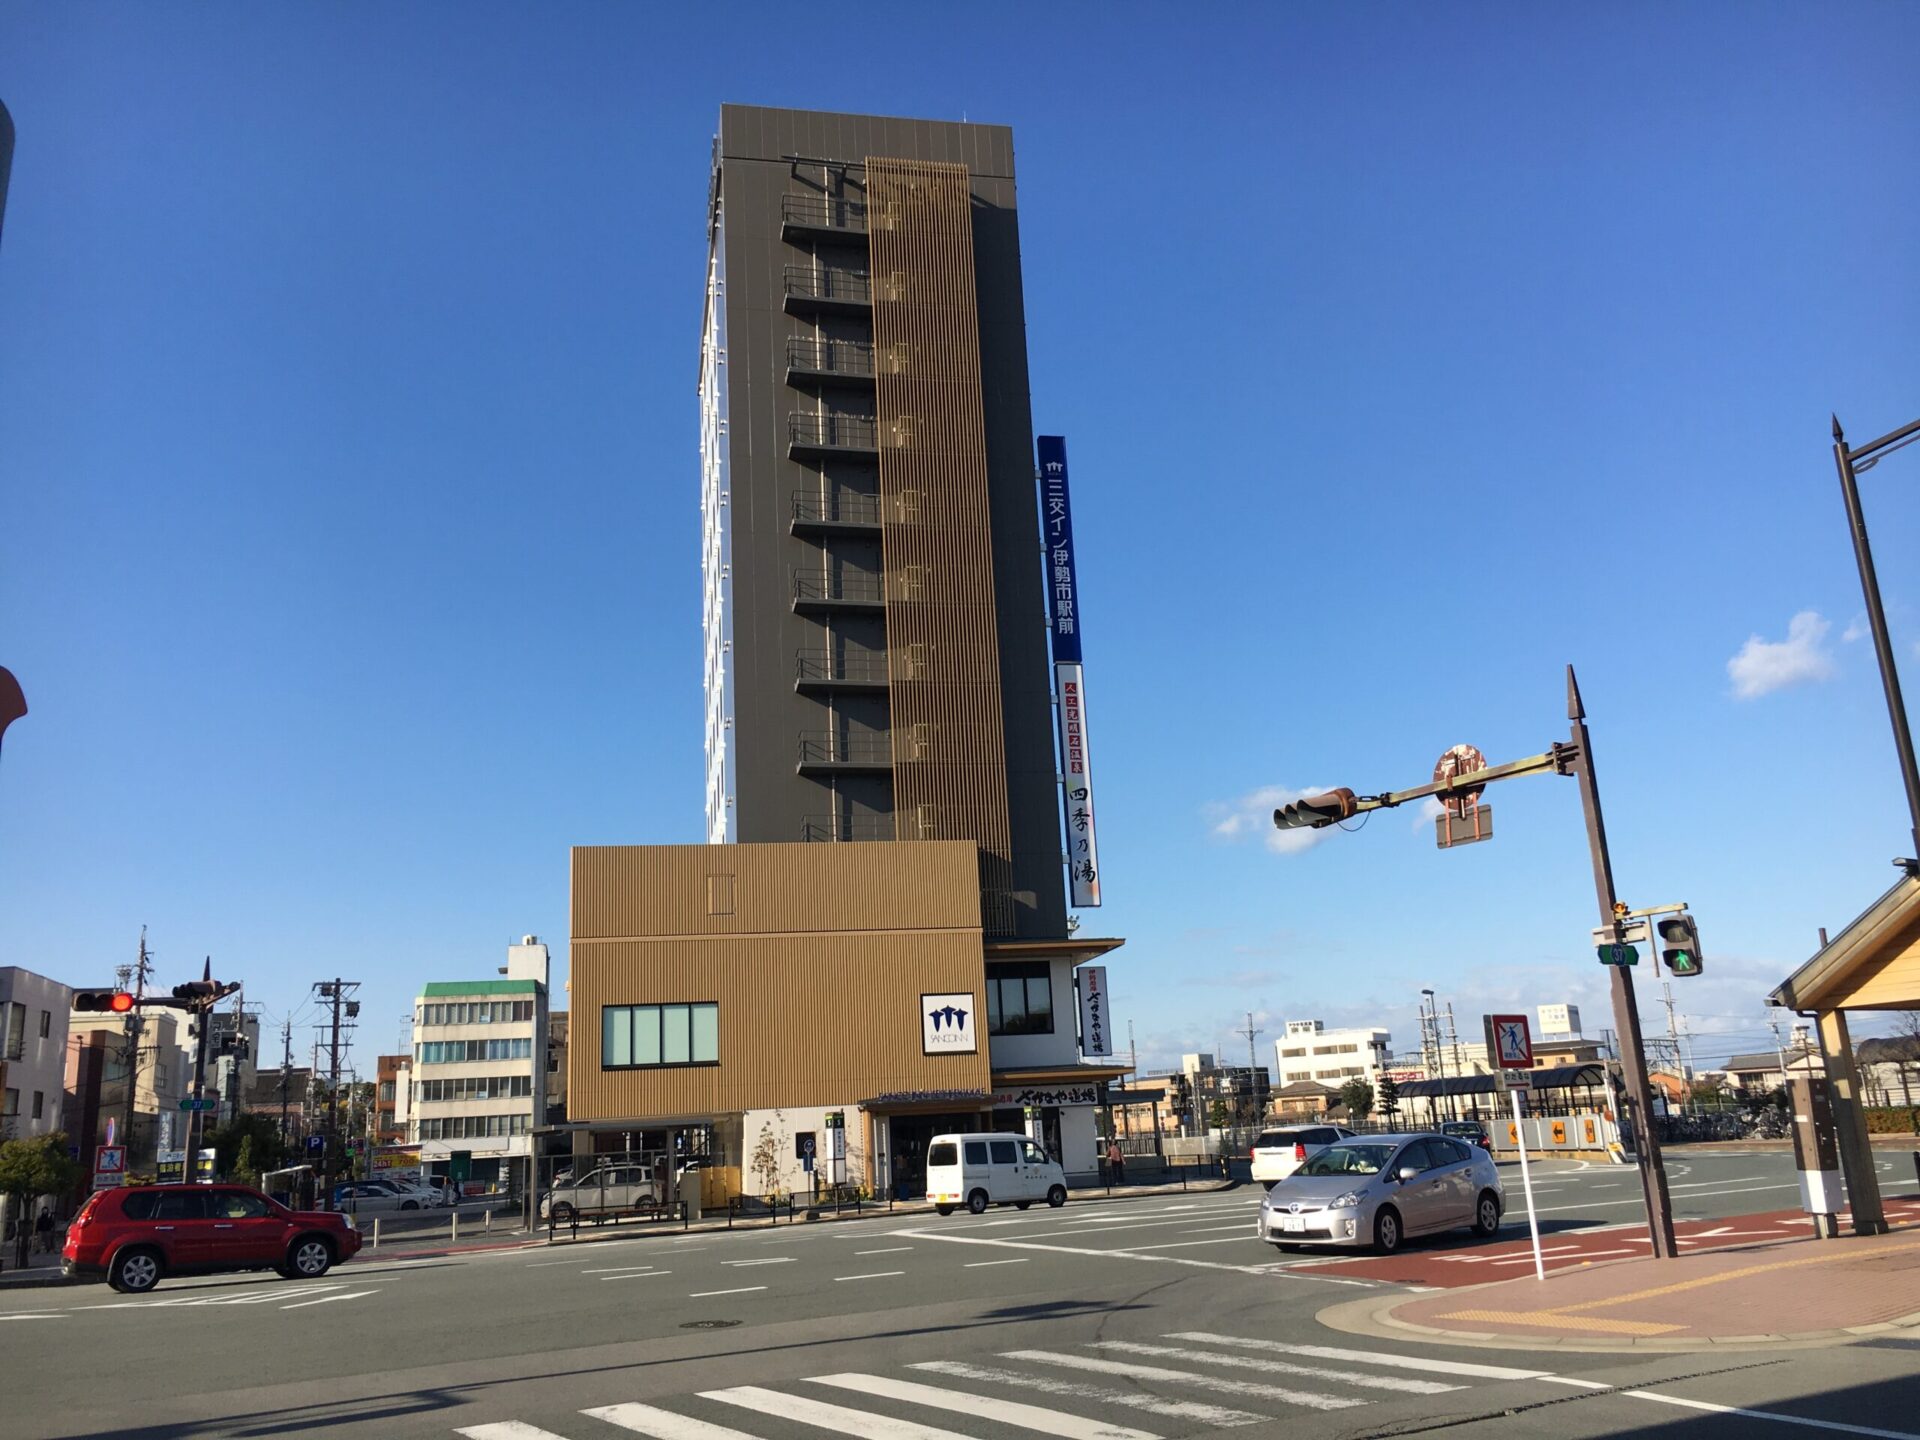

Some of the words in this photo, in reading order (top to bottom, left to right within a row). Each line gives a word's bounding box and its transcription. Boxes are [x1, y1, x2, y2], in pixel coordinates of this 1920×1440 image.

[1048, 478, 1074, 635] 三交イン伊勢市駅前
[1069, 787, 1096, 883] 四季乃湯
[310, 1138, 320, 1148] P
